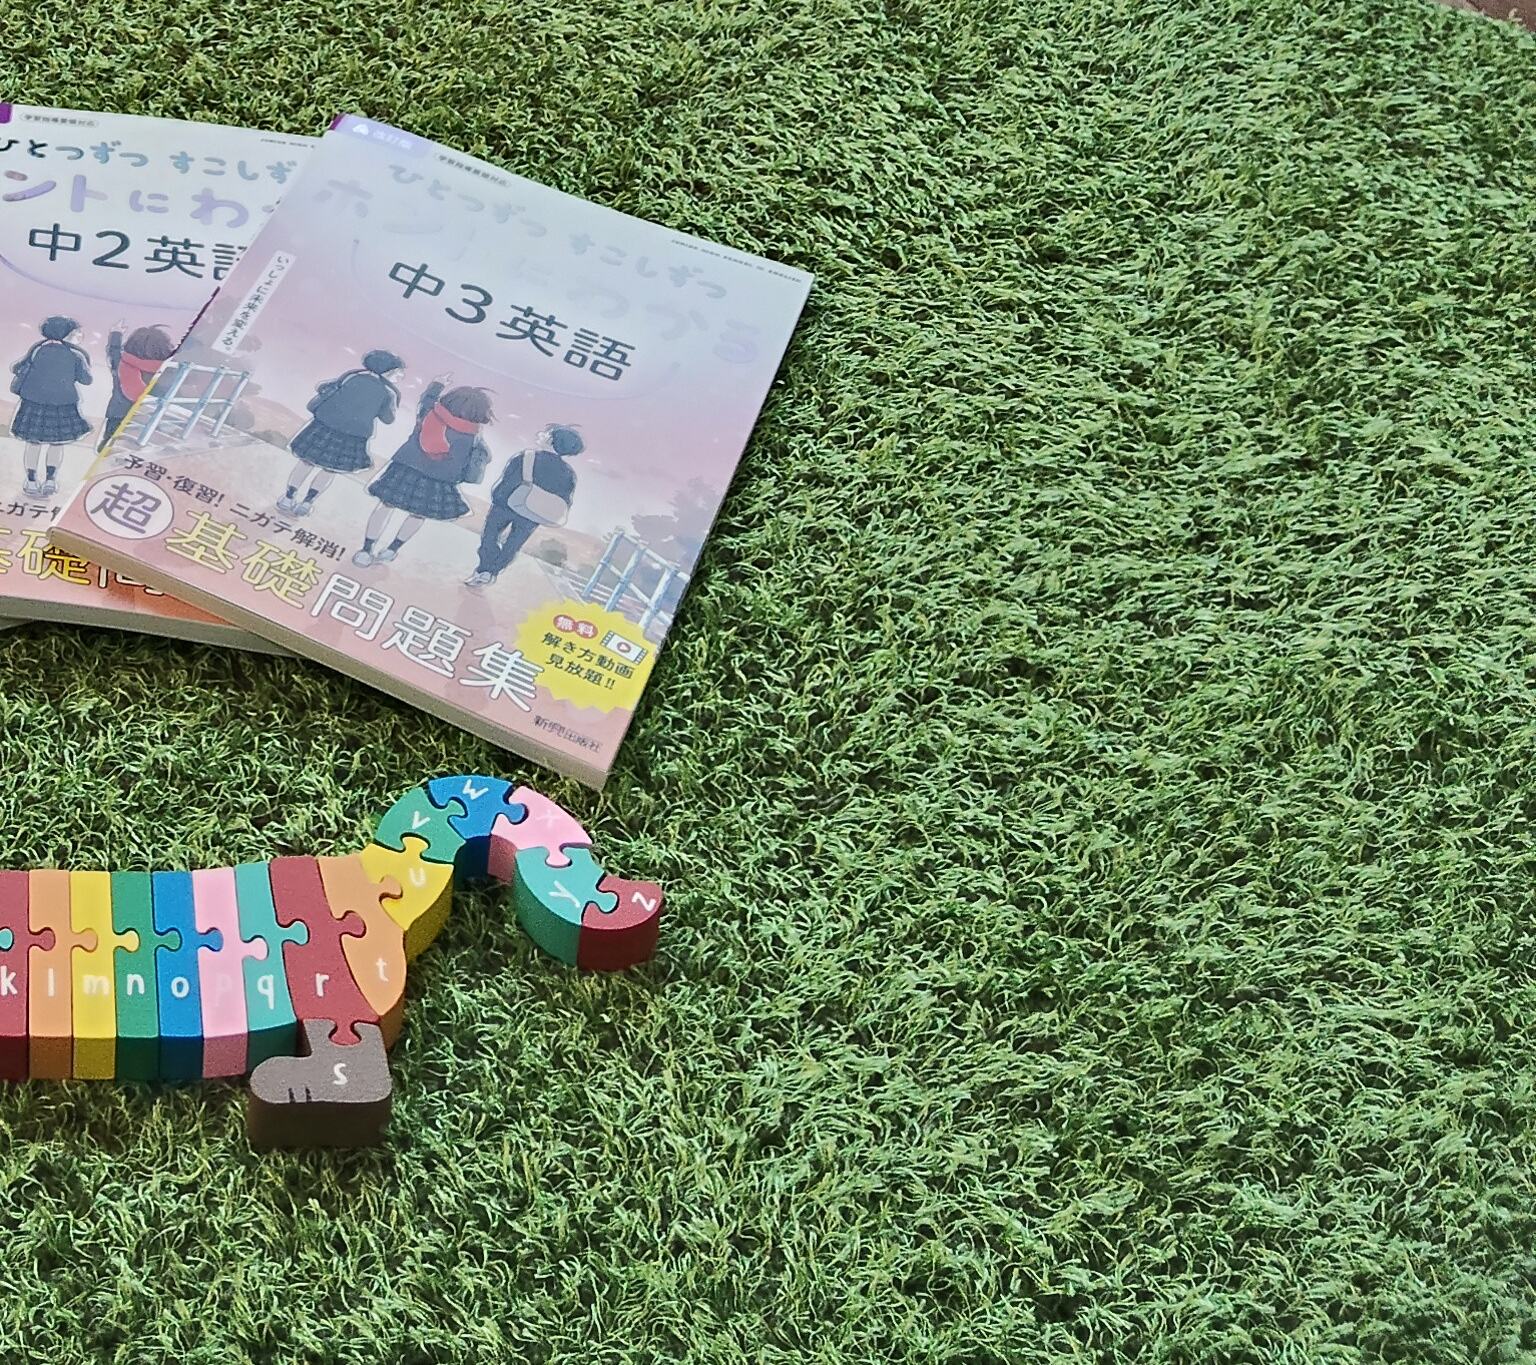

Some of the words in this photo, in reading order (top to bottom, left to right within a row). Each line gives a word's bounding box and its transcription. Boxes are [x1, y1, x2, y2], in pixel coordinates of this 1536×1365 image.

[388, 164, 548, 238] ひとつずつ
[567, 232, 728, 299] すこしずつ
[222, 256, 289, 350] いっしょに未来を変える。
[388, 262, 636, 381] 中3英語
[230, 503, 346, 561] ニガテ解消!
[90, 482, 163, 535] 超
[166, 509, 545, 713] 基礎問題集
[540, 632, 635, 680] 解き方動画
[462, 778, 489, 800] w
[412, 811, 430, 831] v
[536, 808, 561, 827] x
[408, 866, 427, 889] u
[548, 879, 581, 909] y
[631, 890, 656, 911] z
[0, 965, 18, 996] k
[375, 956, 389, 983] t
[82, 973, 110, 996] m
[127, 973, 145, 996] n
[170, 975, 189, 999] o
[213, 972, 231, 1007] p
[257, 974, 275, 1010] q
[315, 972, 330, 997] r
[332, 1062, 348, 1084] s
